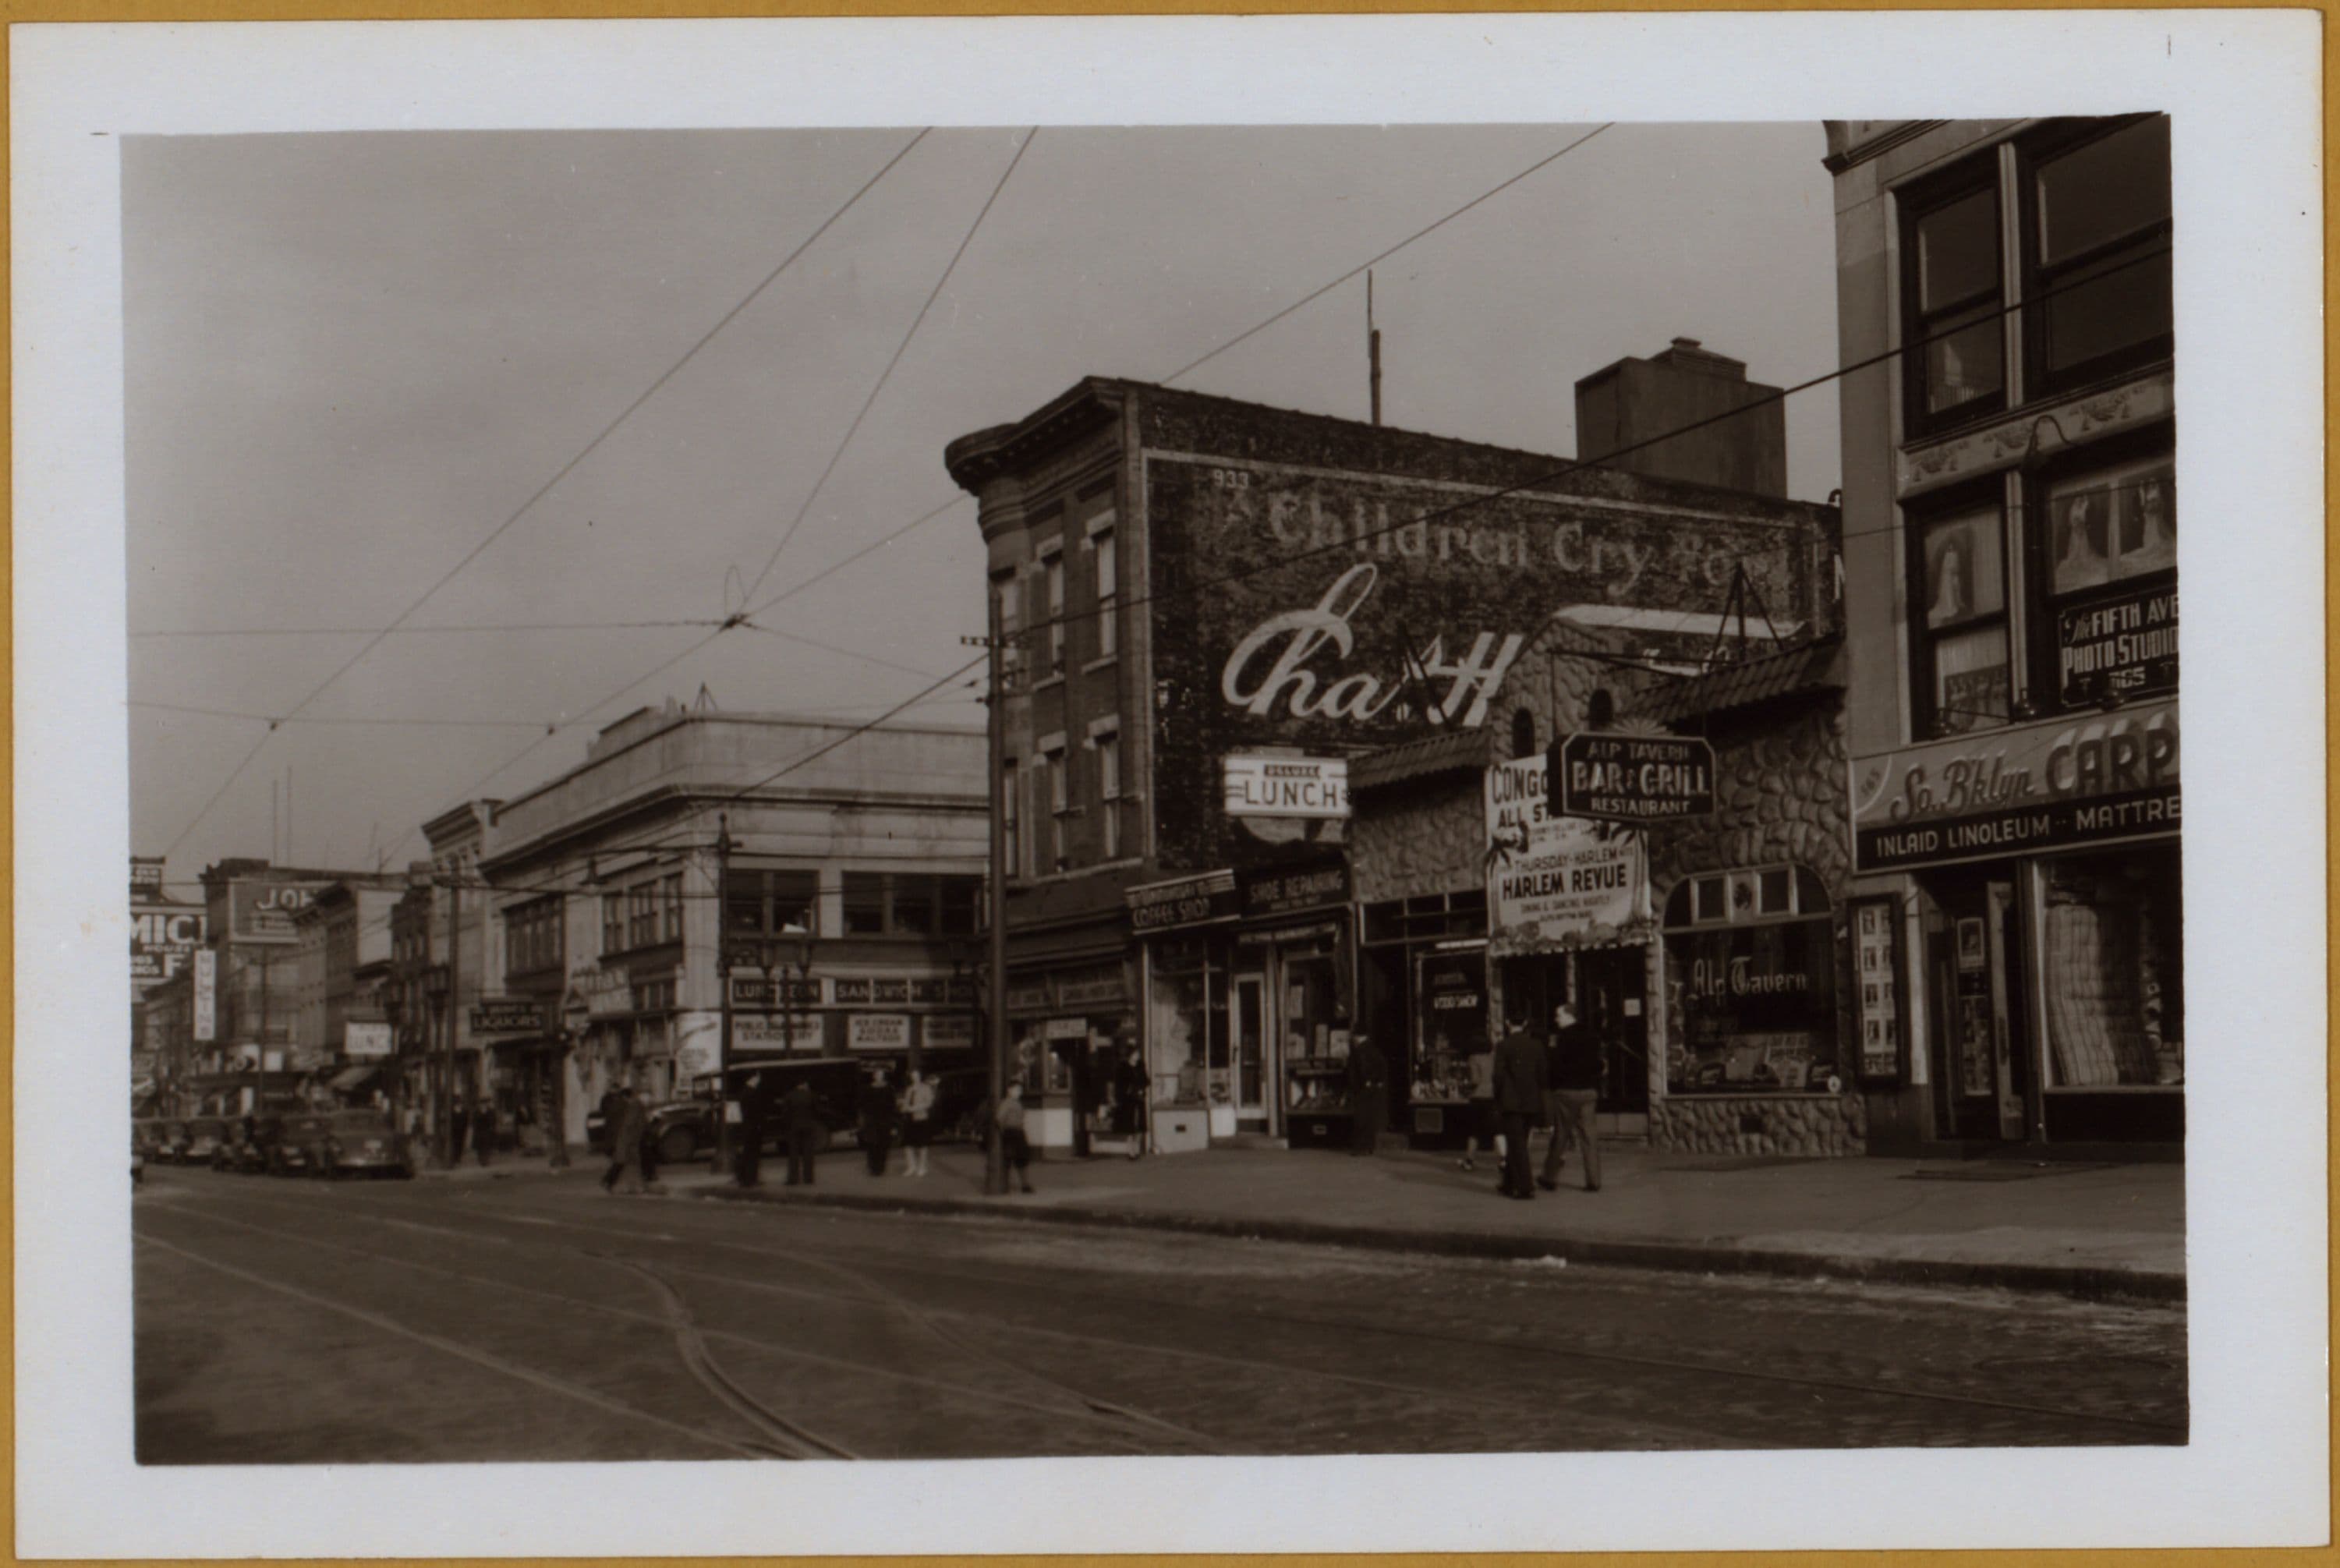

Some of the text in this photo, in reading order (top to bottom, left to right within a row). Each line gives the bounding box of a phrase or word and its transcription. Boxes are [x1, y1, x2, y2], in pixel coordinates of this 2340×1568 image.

[1212, 470, 1248, 489] 933
[1269, 491, 1527, 567] Children
[1555, 521, 1651, 596] Cry
[2092, 603, 2140, 637] FIFTH
[2147, 594, 2178, 624] AVE
[2062, 640, 2115, 689] PHOTO
[1588, 742, 1689, 761] ALP TAVERN
[2044, 712, 2178, 798] CARP
[1244, 780, 1337, 808] LUNCH
[1492, 765, 1549, 805] CONGO
[1572, 760, 1625, 795] BAR
[1639, 763, 1710, 796] GRILL
[1591, 798, 1690, 816] RESTAURANT
[1876, 795, 2180, 858] INLAID LINOLEUM MATTRE
[1502, 862, 1627, 901] HARLEM REVUE
[1693, 955, 1807, 1007] Alp Tavern
